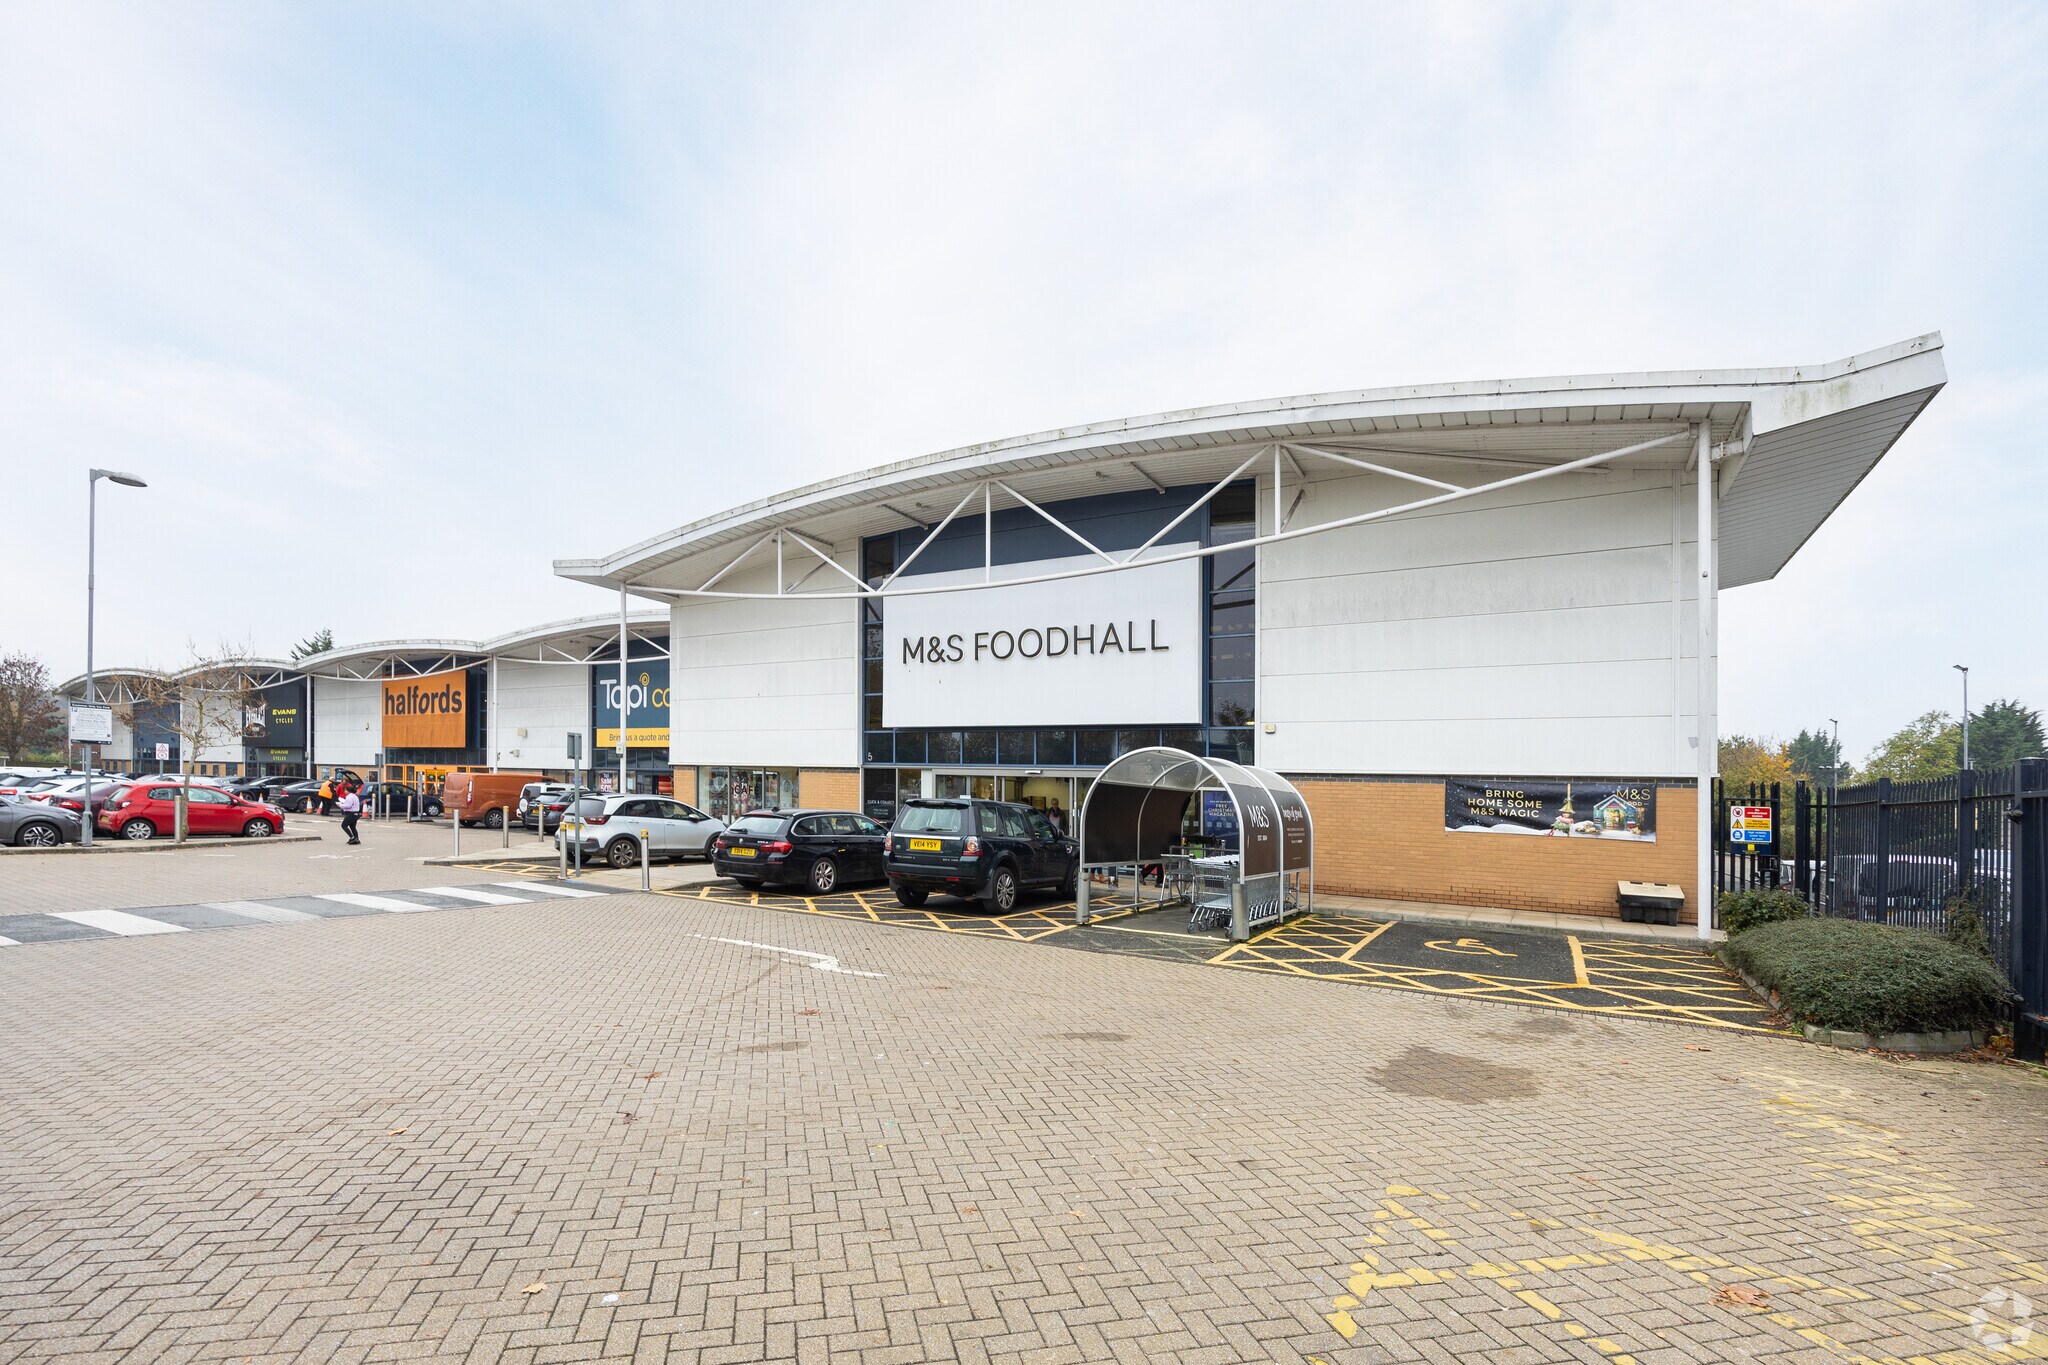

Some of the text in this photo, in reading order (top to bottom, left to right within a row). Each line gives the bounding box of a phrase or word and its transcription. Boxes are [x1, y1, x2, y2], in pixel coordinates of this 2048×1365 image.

[902, 618, 1170, 665] M&S FOODHALL
[384, 683, 463, 715] halfords
[599, 672, 650, 716] Tapi
[272, 708, 297, 716] EVANS
[609, 733, 622, 742] Brin
[639, 733, 657, 743] quote
[657, 732, 670, 742] and
[868, 752, 873, 762] 5
[1485, 789, 1524, 799] BRING
[1616, 787, 1651, 801] M&S
[1467, 798, 1542, 809] HOME SOME
[1246, 804, 1270, 828] M&S
[1470, 807, 1540, 818] M&S MAGIC
